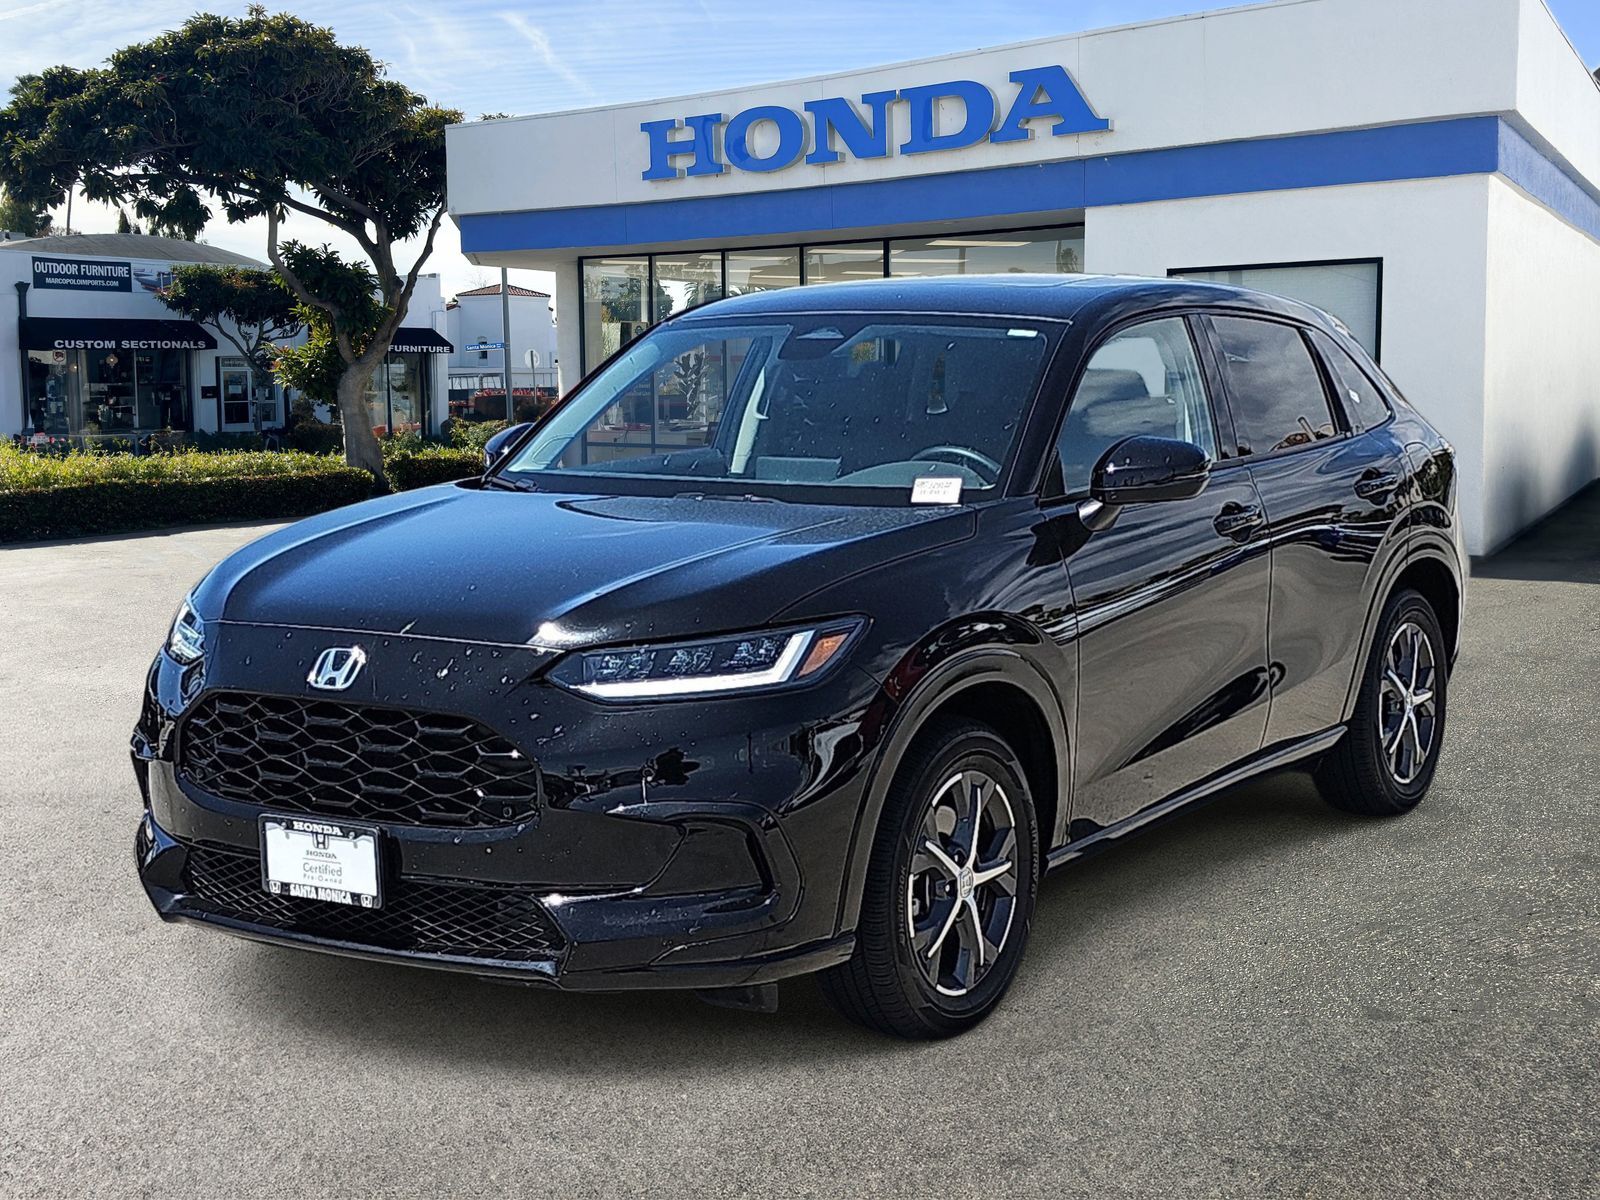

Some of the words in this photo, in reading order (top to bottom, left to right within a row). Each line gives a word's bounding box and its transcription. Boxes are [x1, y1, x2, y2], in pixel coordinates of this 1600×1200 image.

[641, 65, 1111, 181] HONDA
[34, 261, 78, 275] OUTDOOR
[80, 264, 130, 278] FURNITURE
[45, 277, 119, 287] MARCOPOLOIMPORTS.COM
[54, 340, 116, 349] CUSTOM
[121, 340, 206, 349] SECTIONALS
[387, 344, 450, 353] FURNITURE
[292, 820, 343, 836] HONDA
[306, 849, 337, 859] HONDA
[302, 862, 343, 877] Certified
[290, 884, 317, 899] SANTA
[317, 887, 353, 905] MONICA
